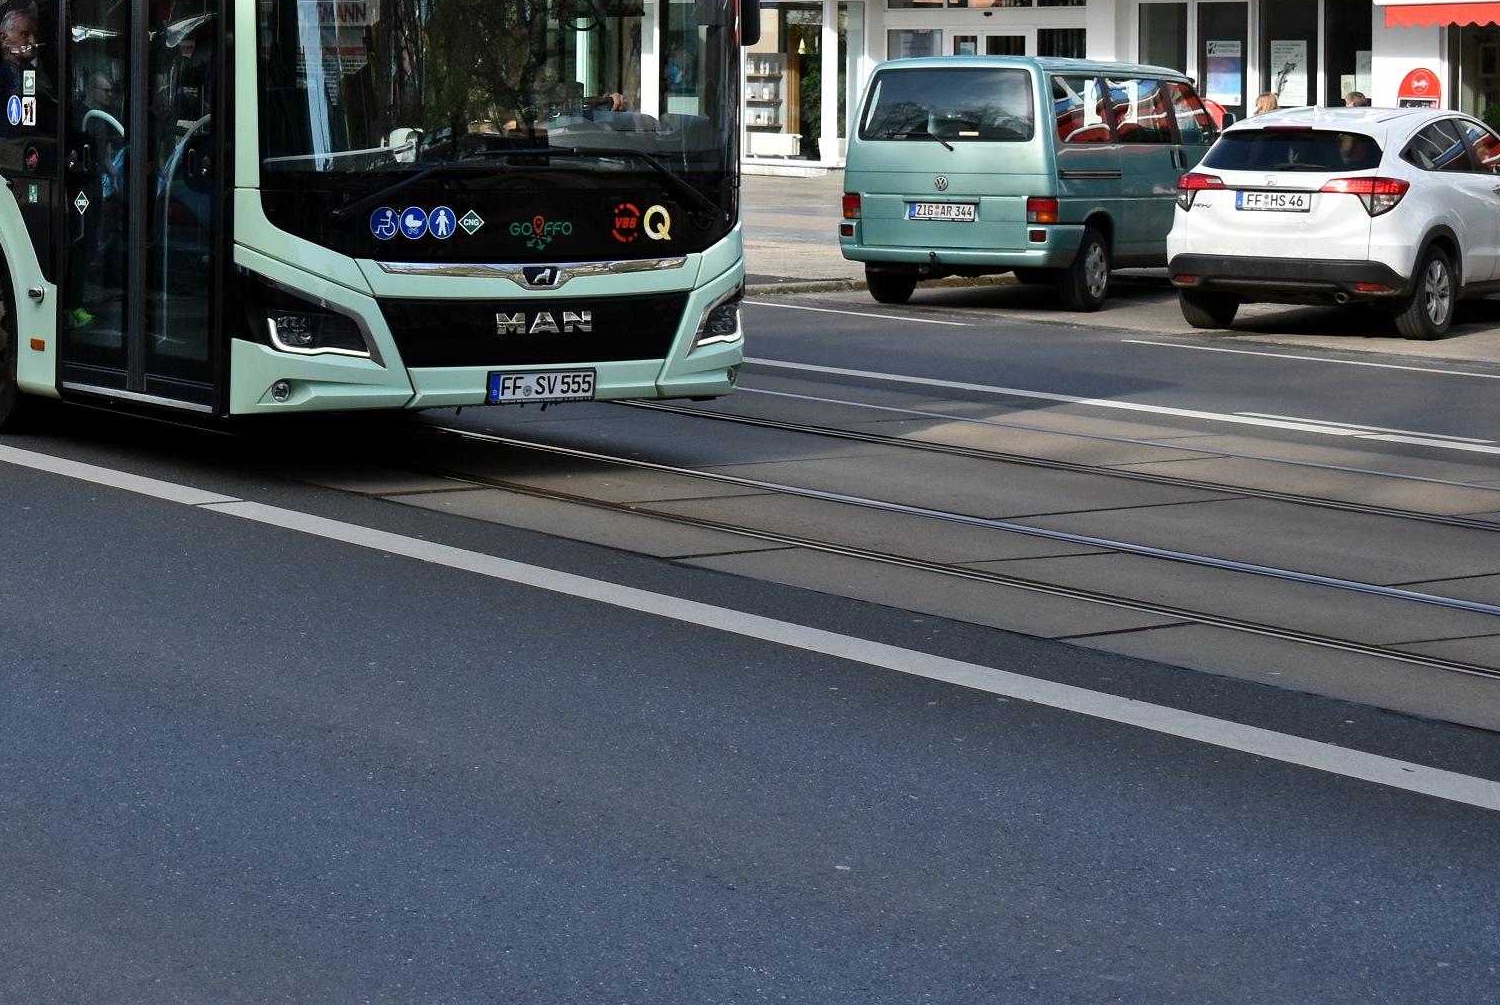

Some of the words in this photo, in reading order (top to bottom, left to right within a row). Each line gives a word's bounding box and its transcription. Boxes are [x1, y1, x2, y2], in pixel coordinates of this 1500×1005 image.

[1246, 193, 1262, 206] FF
[1270, 194, 1286, 207] HS
[1288, 194, 1303, 207] 46
[916, 204, 933, 216] ZIG
[940, 205, 952, 216] AR
[954, 206, 972, 217] 344
[463, 218, 480, 227] CNG
[615, 217, 637, 229] VBB
[643, 204, 672, 241] Q
[496, 311, 593, 335] MAN
[501, 376, 524, 396] FF
[535, 376, 557, 395] SV
[561, 374, 592, 394] 555
